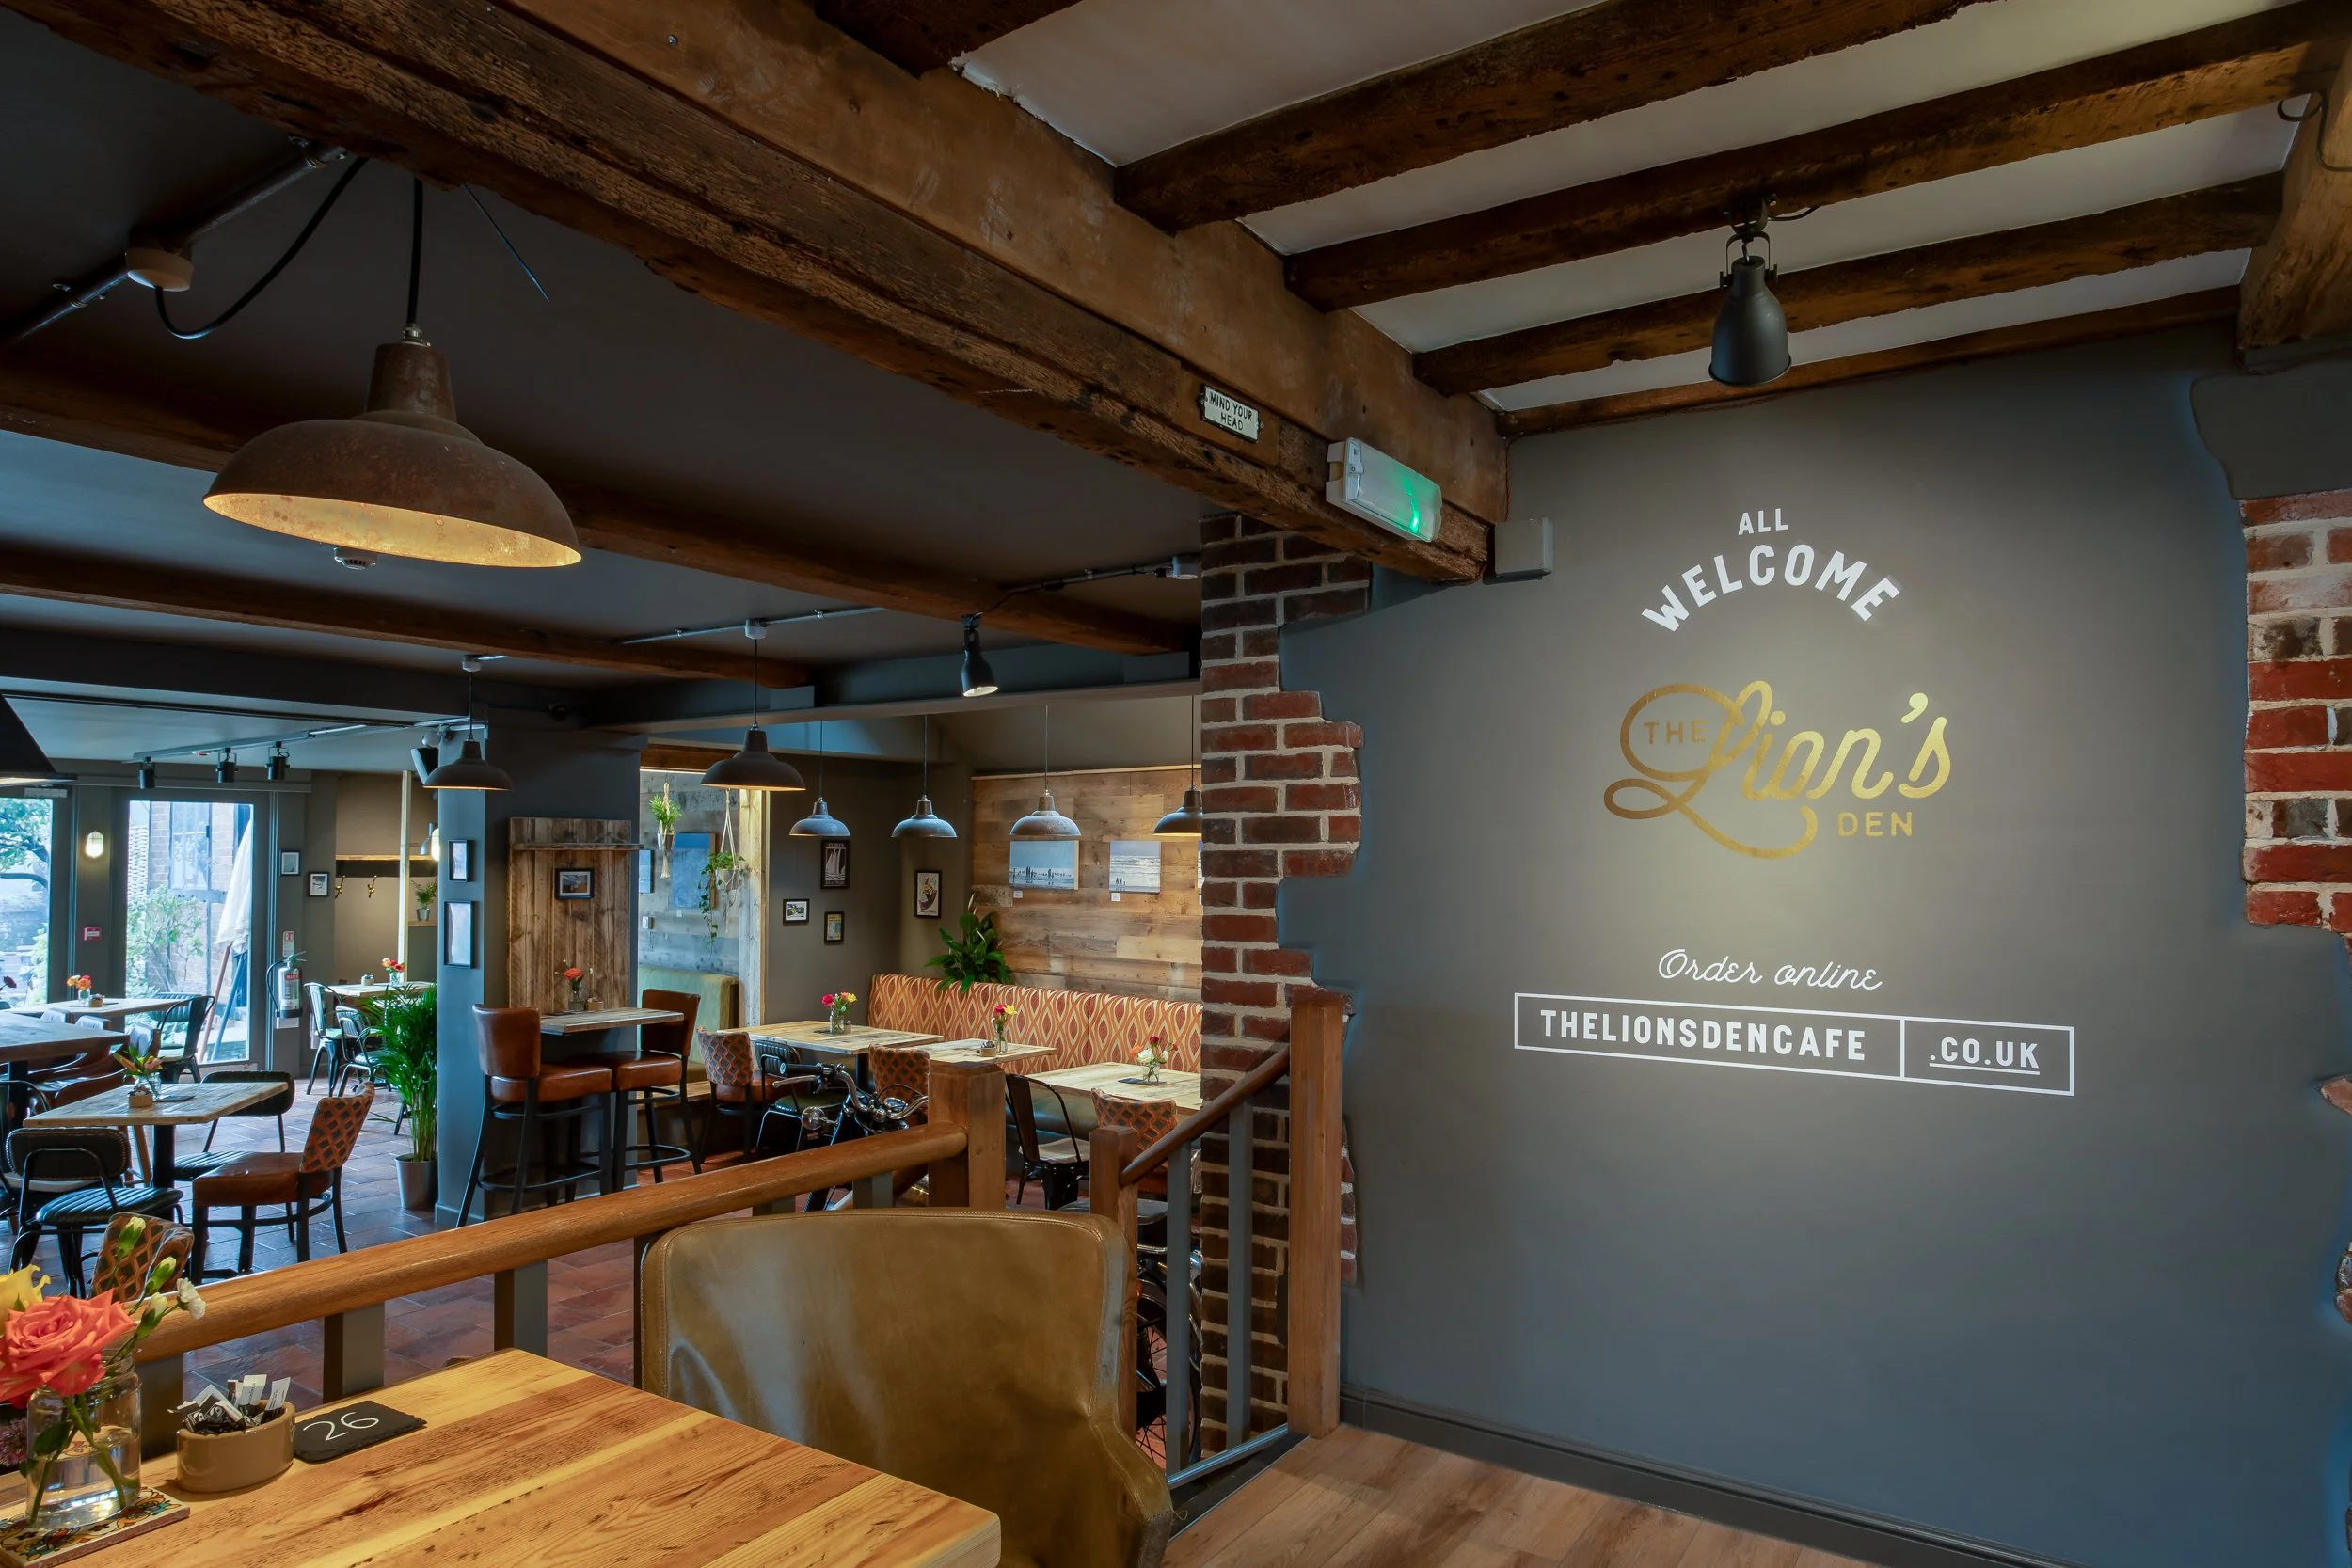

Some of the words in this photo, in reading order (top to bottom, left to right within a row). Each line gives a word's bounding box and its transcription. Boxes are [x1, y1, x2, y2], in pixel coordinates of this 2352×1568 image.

[1209, 391, 1231, 411] MIND
[1232, 403, 1252, 421] YOUR
[1220, 411, 1243, 431] HEAD
[1738, 508, 1788, 536] ALL
[1641, 544, 1900, 632] WELCOME
[1644, 720, 1706, 745] THE
[1604, 680, 1951, 860] Lion's
[1838, 811, 1913, 837] DEN
[1658, 948, 1763, 985] Order
[1774, 959, 1883, 990] online
[1540, 1008, 1866, 1061] THELIONSDENCAFE
[1929, 1037, 2040, 1069] .CO.UK
[303, 1412, 379, 1441] 26
